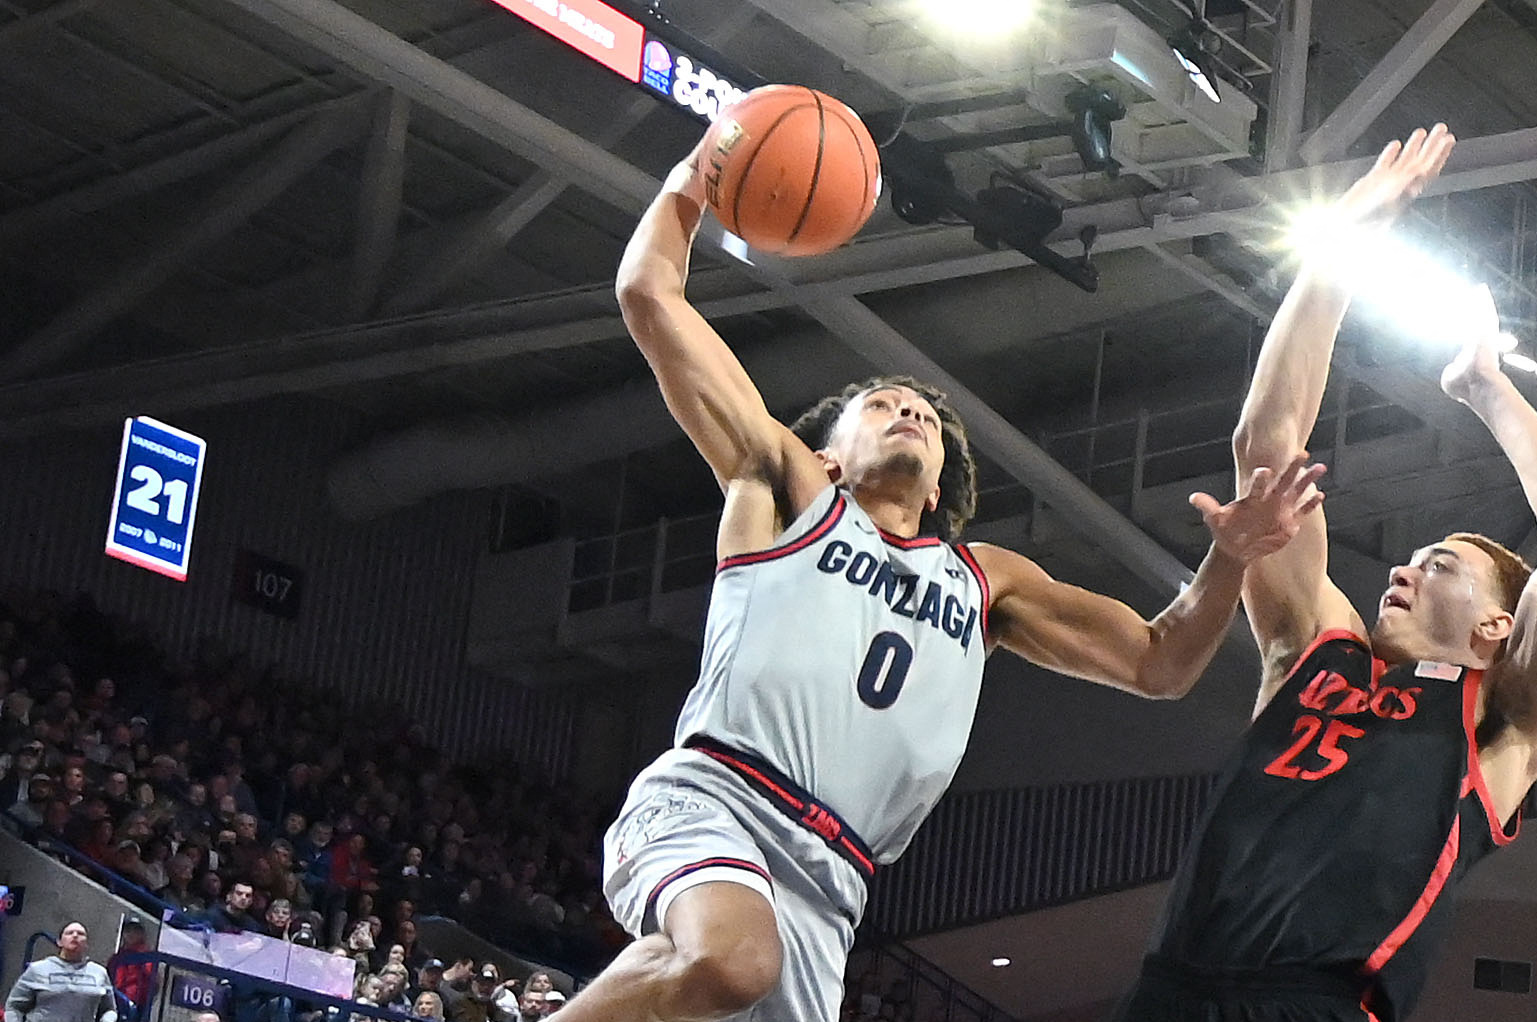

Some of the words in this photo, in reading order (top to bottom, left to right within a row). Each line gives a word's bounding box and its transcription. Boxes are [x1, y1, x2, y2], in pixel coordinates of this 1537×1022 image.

[127, 464, 188, 524] 21
[256, 569, 292, 600] 107
[856, 631, 914, 710] 0
[1264, 715, 1365, 780] 25
[182, 985, 215, 1007] 106
